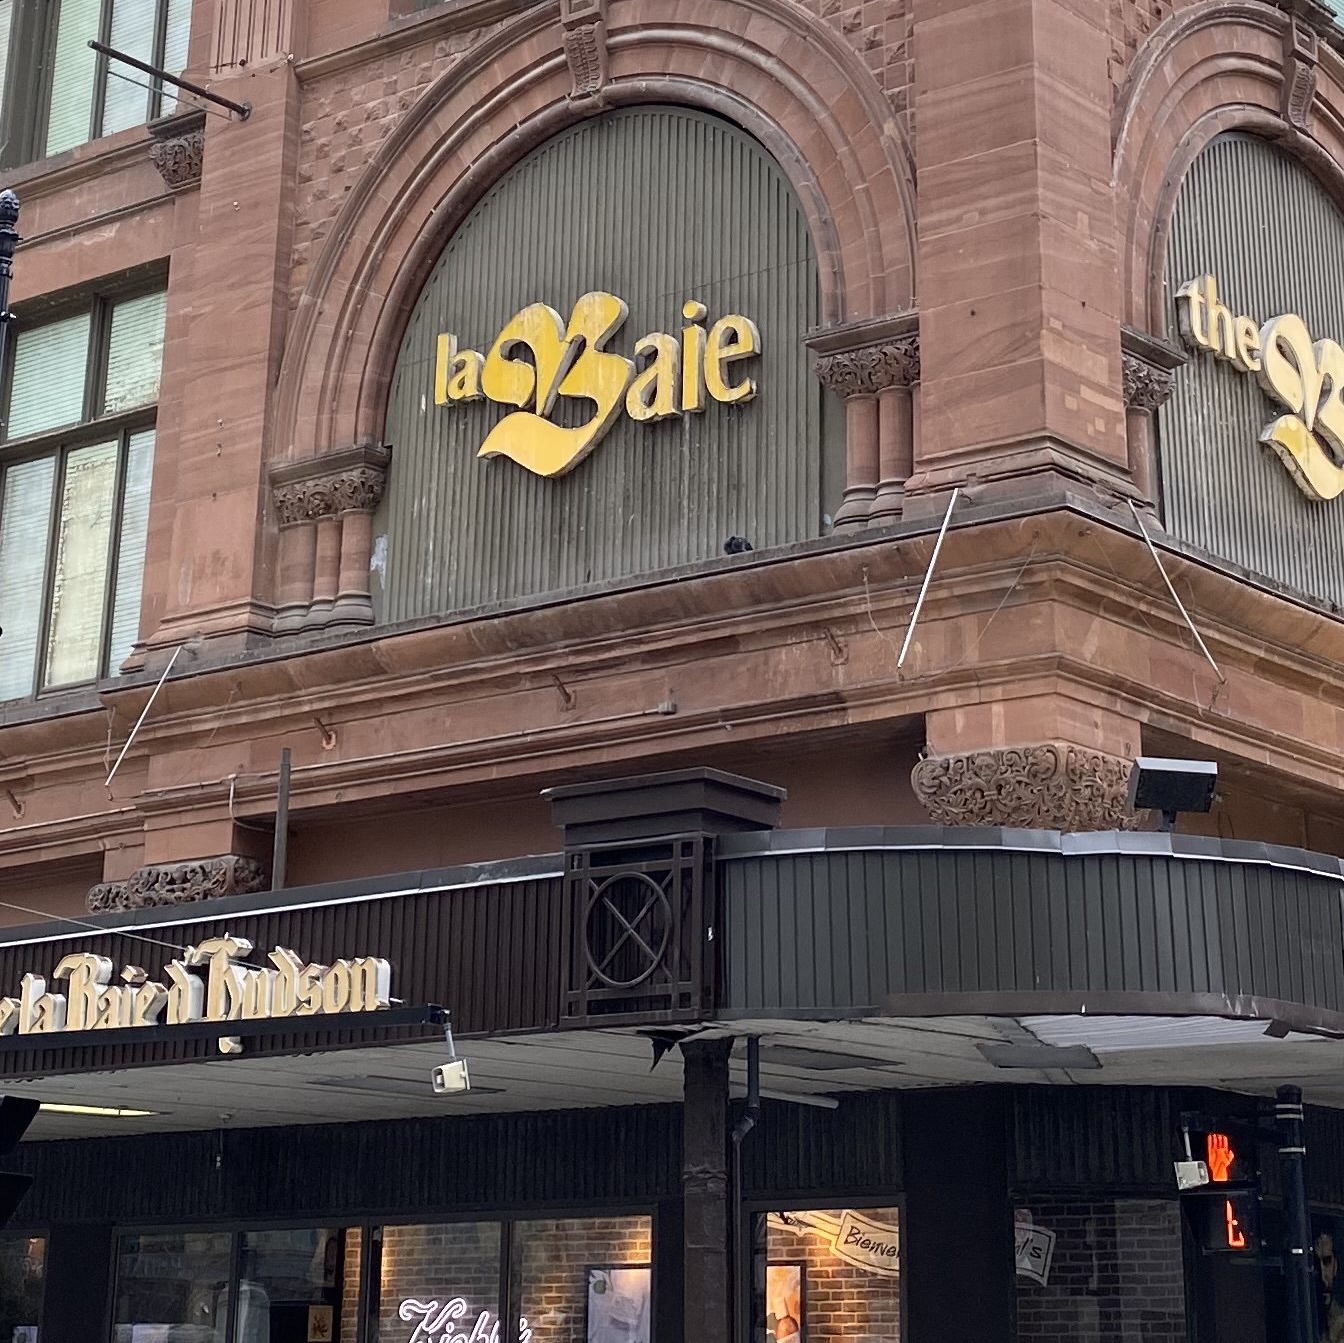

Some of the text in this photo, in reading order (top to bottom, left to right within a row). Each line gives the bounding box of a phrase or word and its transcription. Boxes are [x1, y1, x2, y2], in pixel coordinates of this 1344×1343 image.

[1174, 273, 1261, 372] the
[435, 291, 762, 478] la Baie
[18, 973, 68, 1035] la
[53, 952, 169, 1032] Baie
